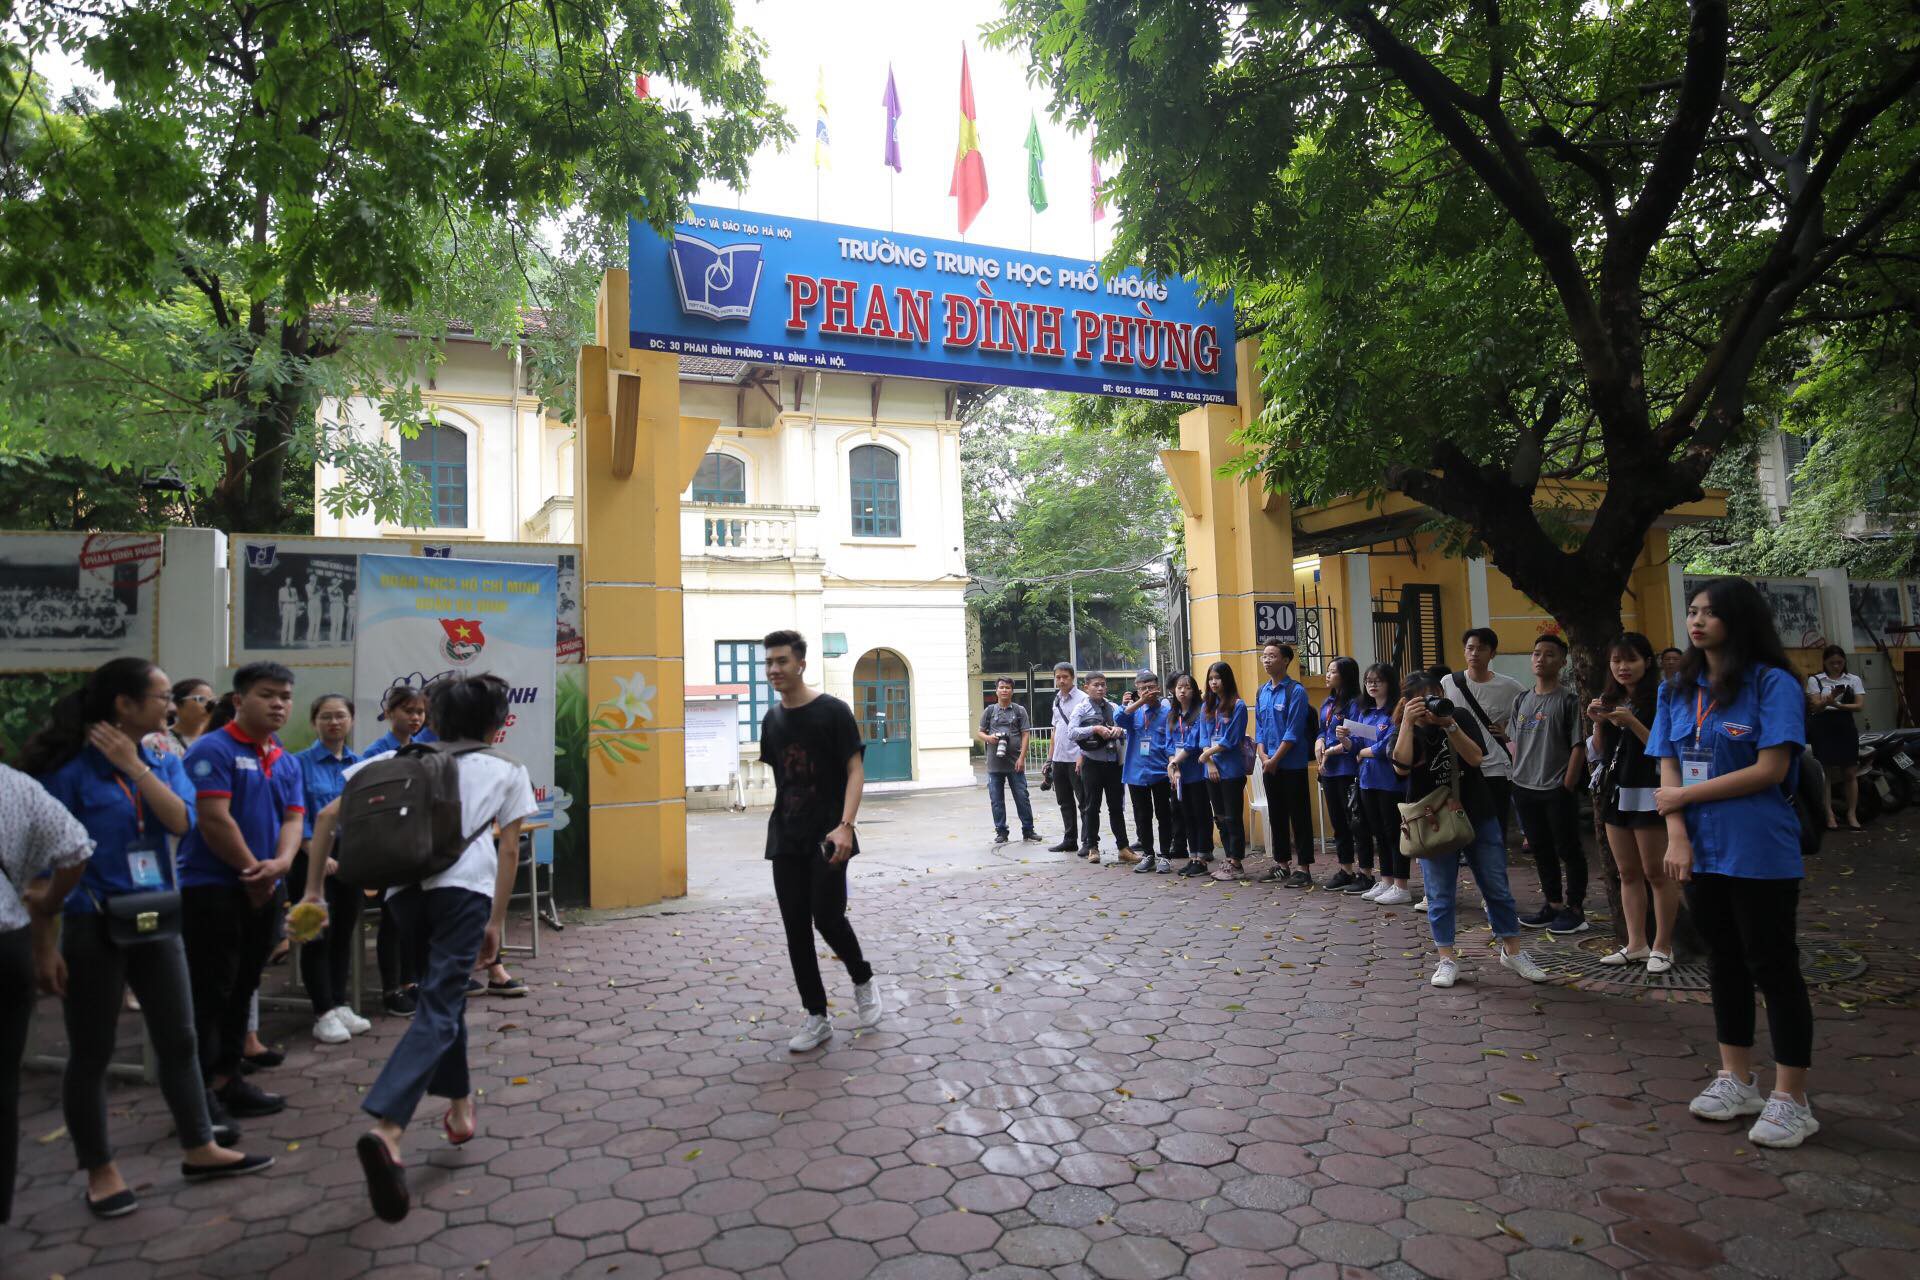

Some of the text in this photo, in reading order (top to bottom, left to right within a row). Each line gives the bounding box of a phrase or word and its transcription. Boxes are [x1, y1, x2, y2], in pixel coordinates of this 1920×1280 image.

[709, 217, 720, 229] VÀ
[722, 219, 740, 232] ĐÀO
[742, 223, 759, 235] TẠO
[762, 225, 774, 236] HÀ
[777, 227, 792, 240] NỘI
[838, 236, 1168, 302] TRƯỜNG TRUNG HỌC PHỔ THÔNG
[785, 272, 1222, 375] PHAN ĐÌNH PHÙNG
[650, 339, 846, 369] ĐC: 30 PHAN ĐÌNH PHÙNG BA ĐÌNH HÀ NỘI.
[1115, 385, 1132, 394] 0243
[1259, 605, 1294, 630] 30
